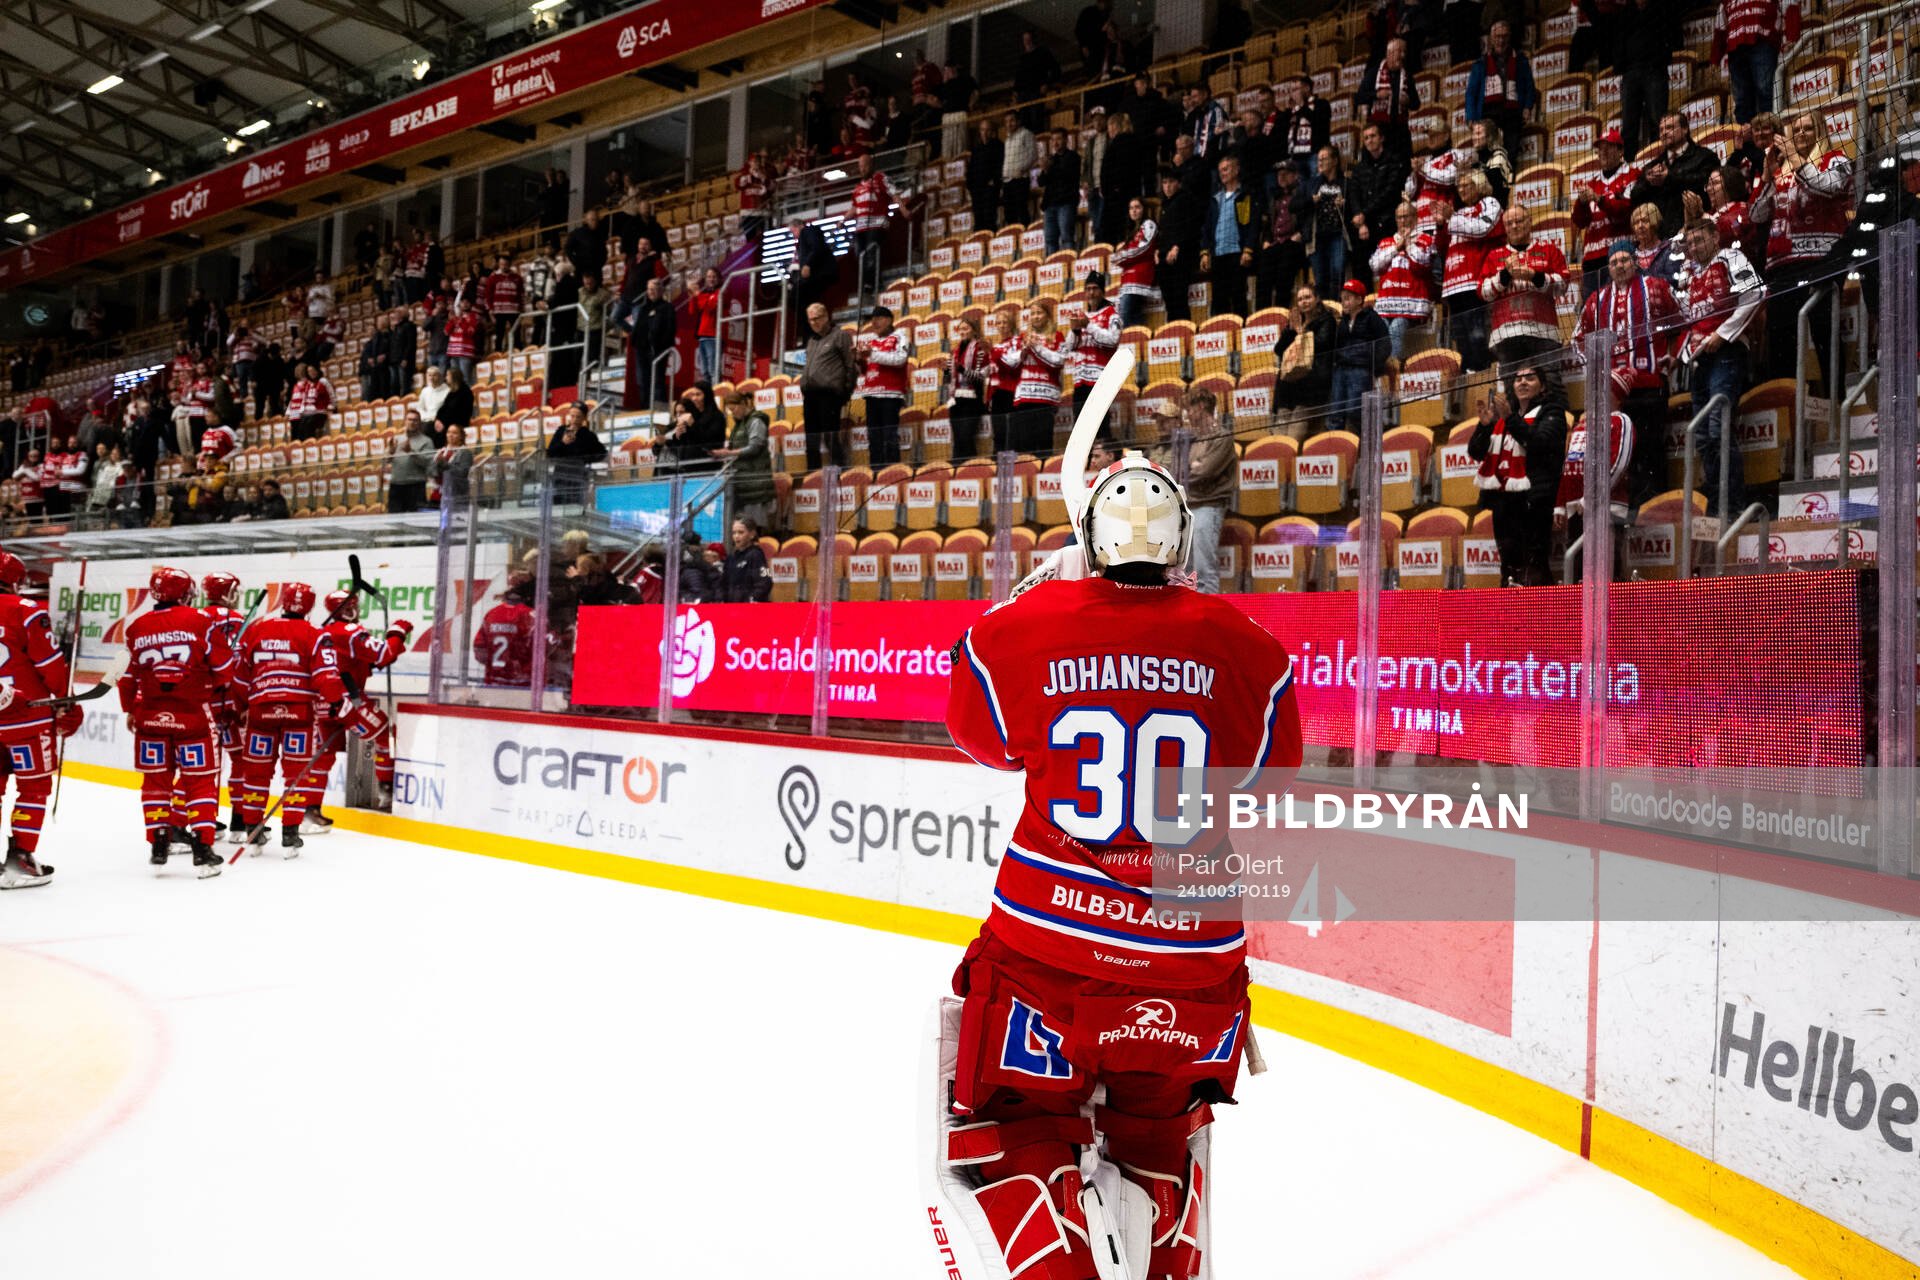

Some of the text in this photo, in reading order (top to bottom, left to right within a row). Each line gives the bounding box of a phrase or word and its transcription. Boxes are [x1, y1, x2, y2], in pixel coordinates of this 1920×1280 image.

[639, 18, 671, 46] SCA
[1793, 77, 1828, 93] MAXI
[399, 103, 450, 134] PEAB
[261, 161, 286, 182] NHC
[1516, 187, 1548, 201] MAXI
[1196, 338, 1224, 352] MAXI
[1246, 332, 1277, 346] MAXI
[1152, 345, 1176, 356] MAXI
[1236, 396, 1265, 409] MAXI
[1243, 469, 1276, 483] MAXI
[1300, 463, 1334, 476] MAXI
[796, 495, 817, 505] MAXI
[873, 492, 895, 502] MAXI
[909, 488, 933, 498] MAXI
[952, 487, 976, 498] MAXI
[1254, 553, 1290, 567] MAXI
[1402, 550, 1439, 565] MAXI
[773, 563, 795, 575] MAXI
[852, 563, 875, 573] MAXI
[893, 562, 918, 573] MAXI
[938, 560, 963, 571] MAXI
[133, 631, 197, 650] JOHANSSON
[1043, 655, 1215, 699] JOHANSSON
[828, 684, 877, 702] TIMRÅ
[1390, 706, 1464, 734] TIMRÅ
[1048, 705, 1212, 846] 30
[517, 808, 649, 841] PART OF ELEDA
[1742, 802, 1870, 848] Banderoller
[829, 798, 1001, 867] sprent
[1287, 861, 1323, 938] 4
[1050, 885, 1202, 932] BILBOLAGET
[1098, 1025, 1200, 1049] PROLYMPIA
[1713, 1001, 1919, 1153] Hellbe
